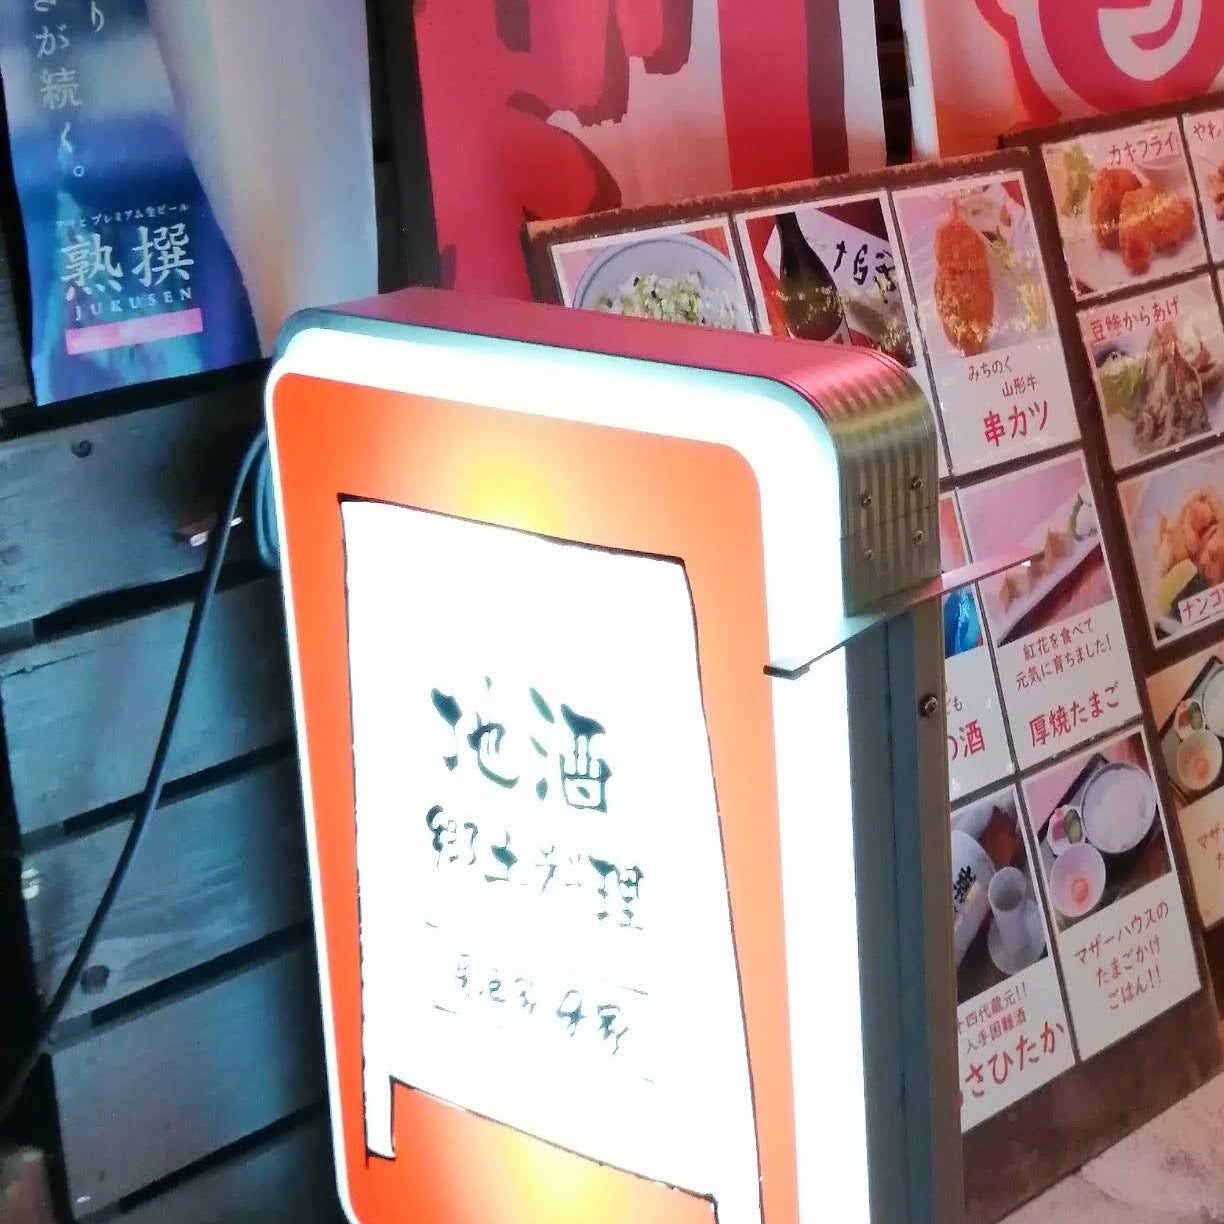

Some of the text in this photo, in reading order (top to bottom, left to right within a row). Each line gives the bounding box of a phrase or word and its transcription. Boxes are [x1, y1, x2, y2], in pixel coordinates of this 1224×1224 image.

[60, 222, 195, 302] 熟撰
[74, 286, 193, 322] JUKUSEN
[968, 355, 1013, 383] みちのく
[1001, 373, 1038, 397] 山形牛
[983, 400, 1048, 447] 串カツ
[1022, 618, 1094, 662] 紅花を食べて
[1028, 680, 1120, 748] 厚焼たまご
[1073, 900, 1169, 965] マザーハウスの
[1096, 934, 1161, 989] たまごかけ
